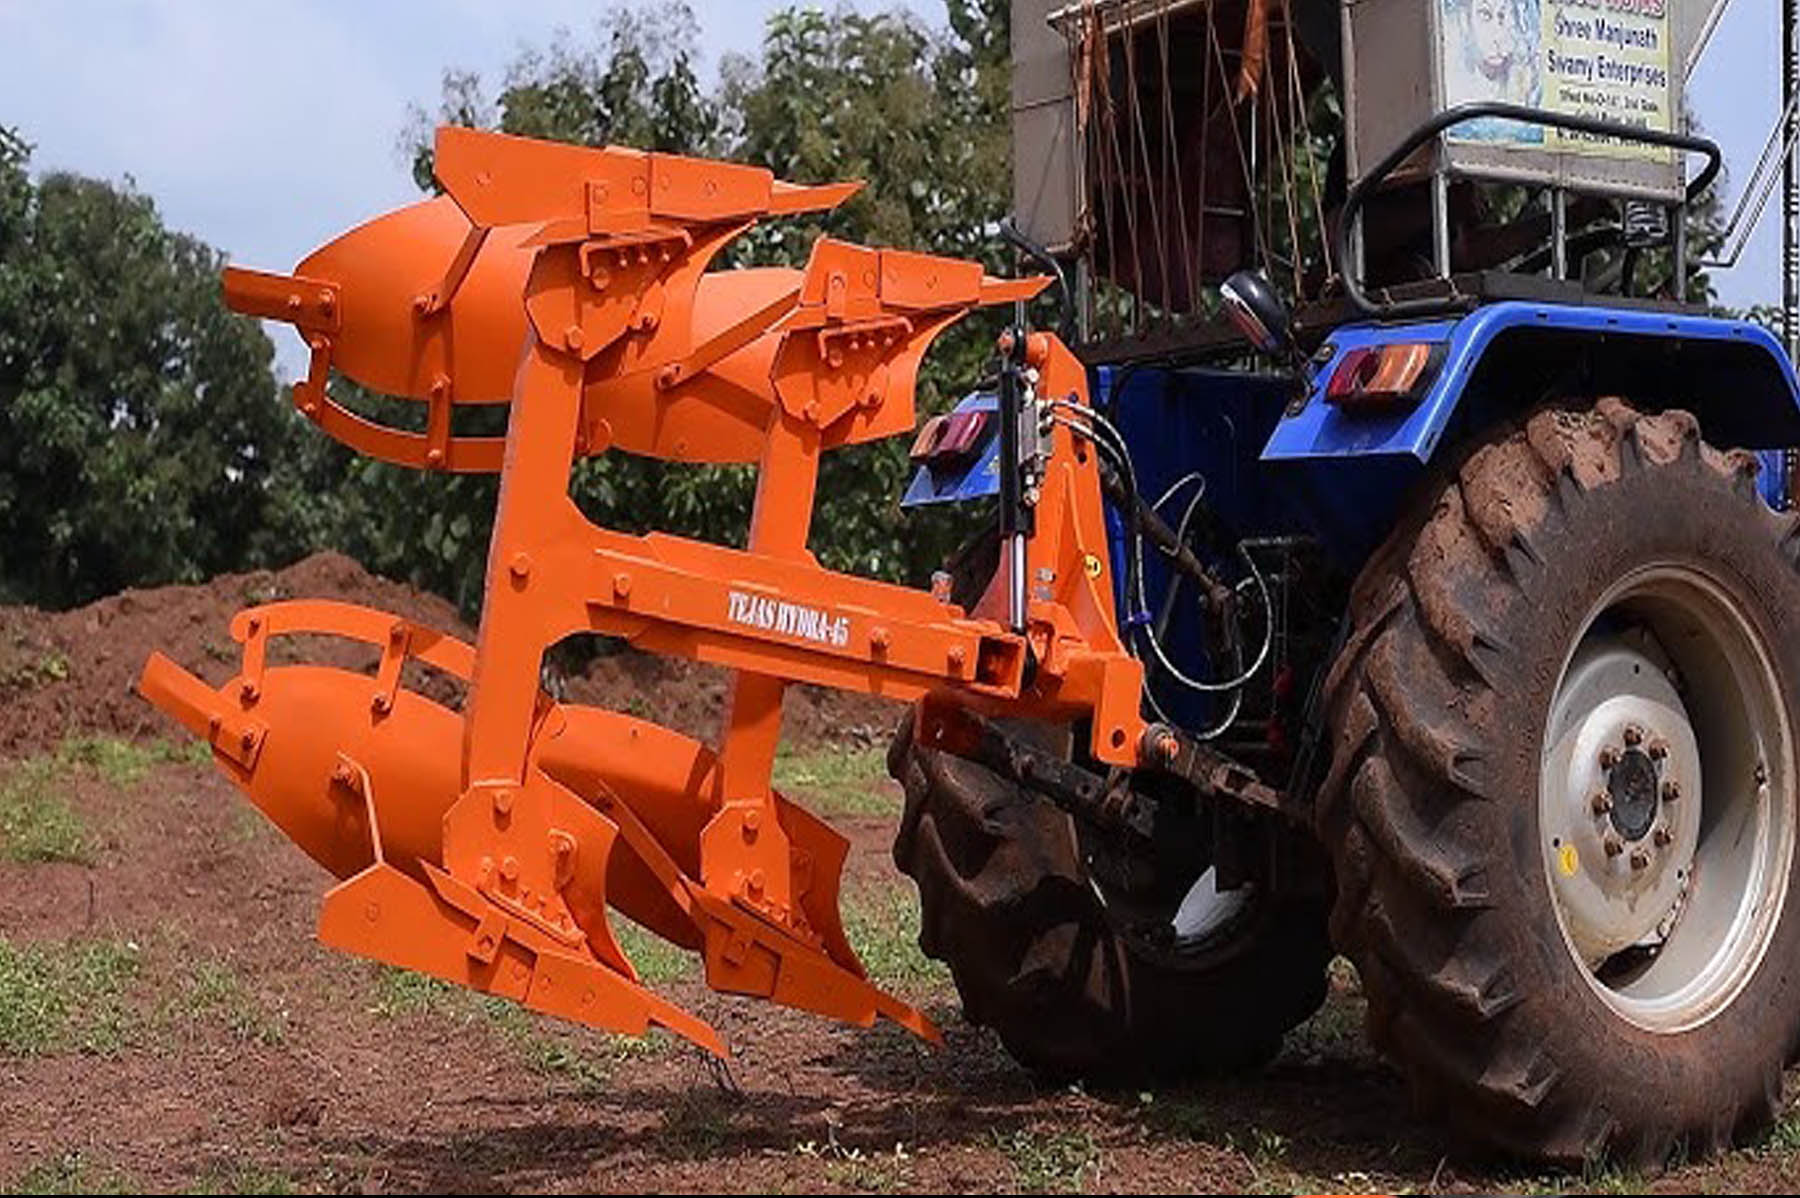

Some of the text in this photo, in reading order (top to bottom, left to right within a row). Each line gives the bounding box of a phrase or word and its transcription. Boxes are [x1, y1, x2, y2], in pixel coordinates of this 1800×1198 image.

[1595, 18, 1658, 49] Manjunath
[1598, 55, 1666, 87] Enterprises
[727, 591, 777, 630] TEJAS
